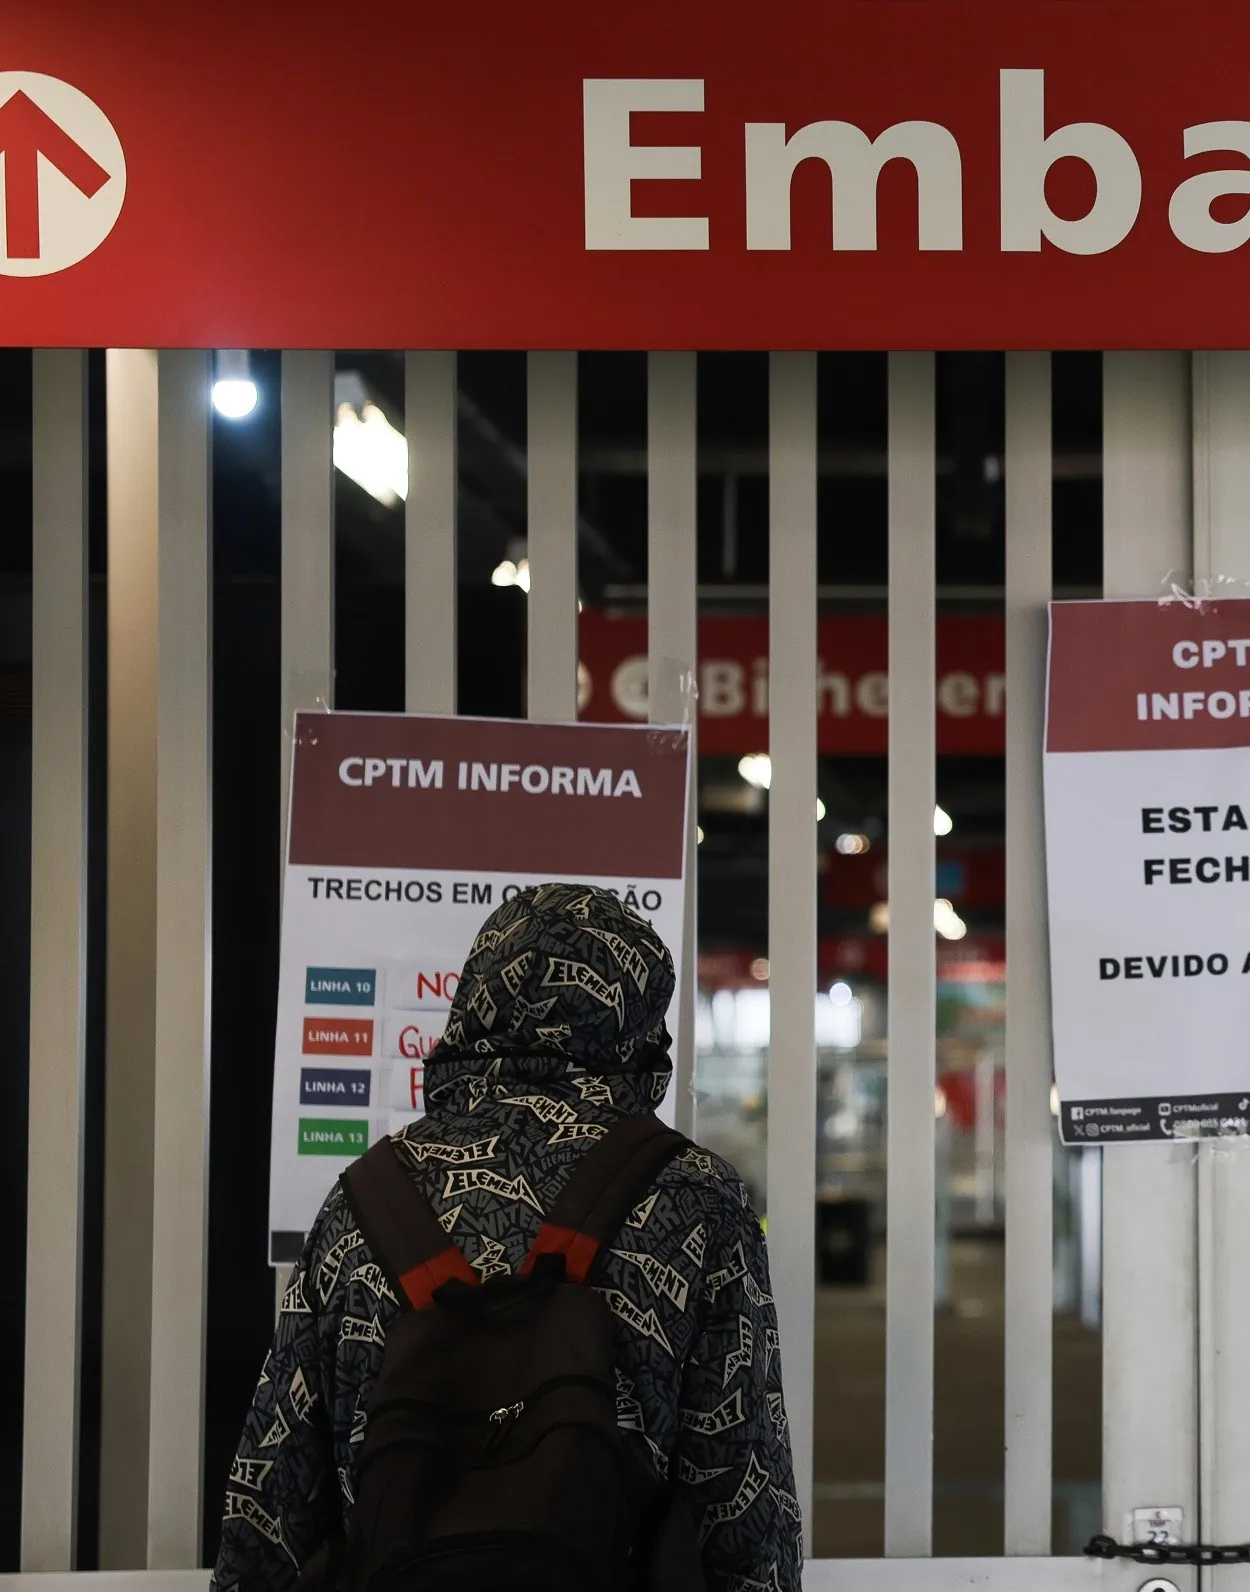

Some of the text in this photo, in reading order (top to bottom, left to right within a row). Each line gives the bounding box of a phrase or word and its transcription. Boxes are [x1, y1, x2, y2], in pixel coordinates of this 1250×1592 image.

[338, 756, 642, 798] CPTM INFORMA
[307, 877, 443, 904] TRECHOS
[452, 881, 493, 905] EM
[1099, 952, 1229, 980] DEVIDO
[310, 979, 371, 994] LINHA 10
[545, 957, 625, 1018] ELEMENT
[308, 1030, 368, 1043] LINHA 11
[304, 1081, 365, 1094] LINHA 12
[303, 1131, 364, 1145] LINHA 13
[406, 1137, 499, 1164] ELEMENT
[444, 1169, 543, 1214] ELEMENT
[615, 1250, 689, 1310] ELEMENT
